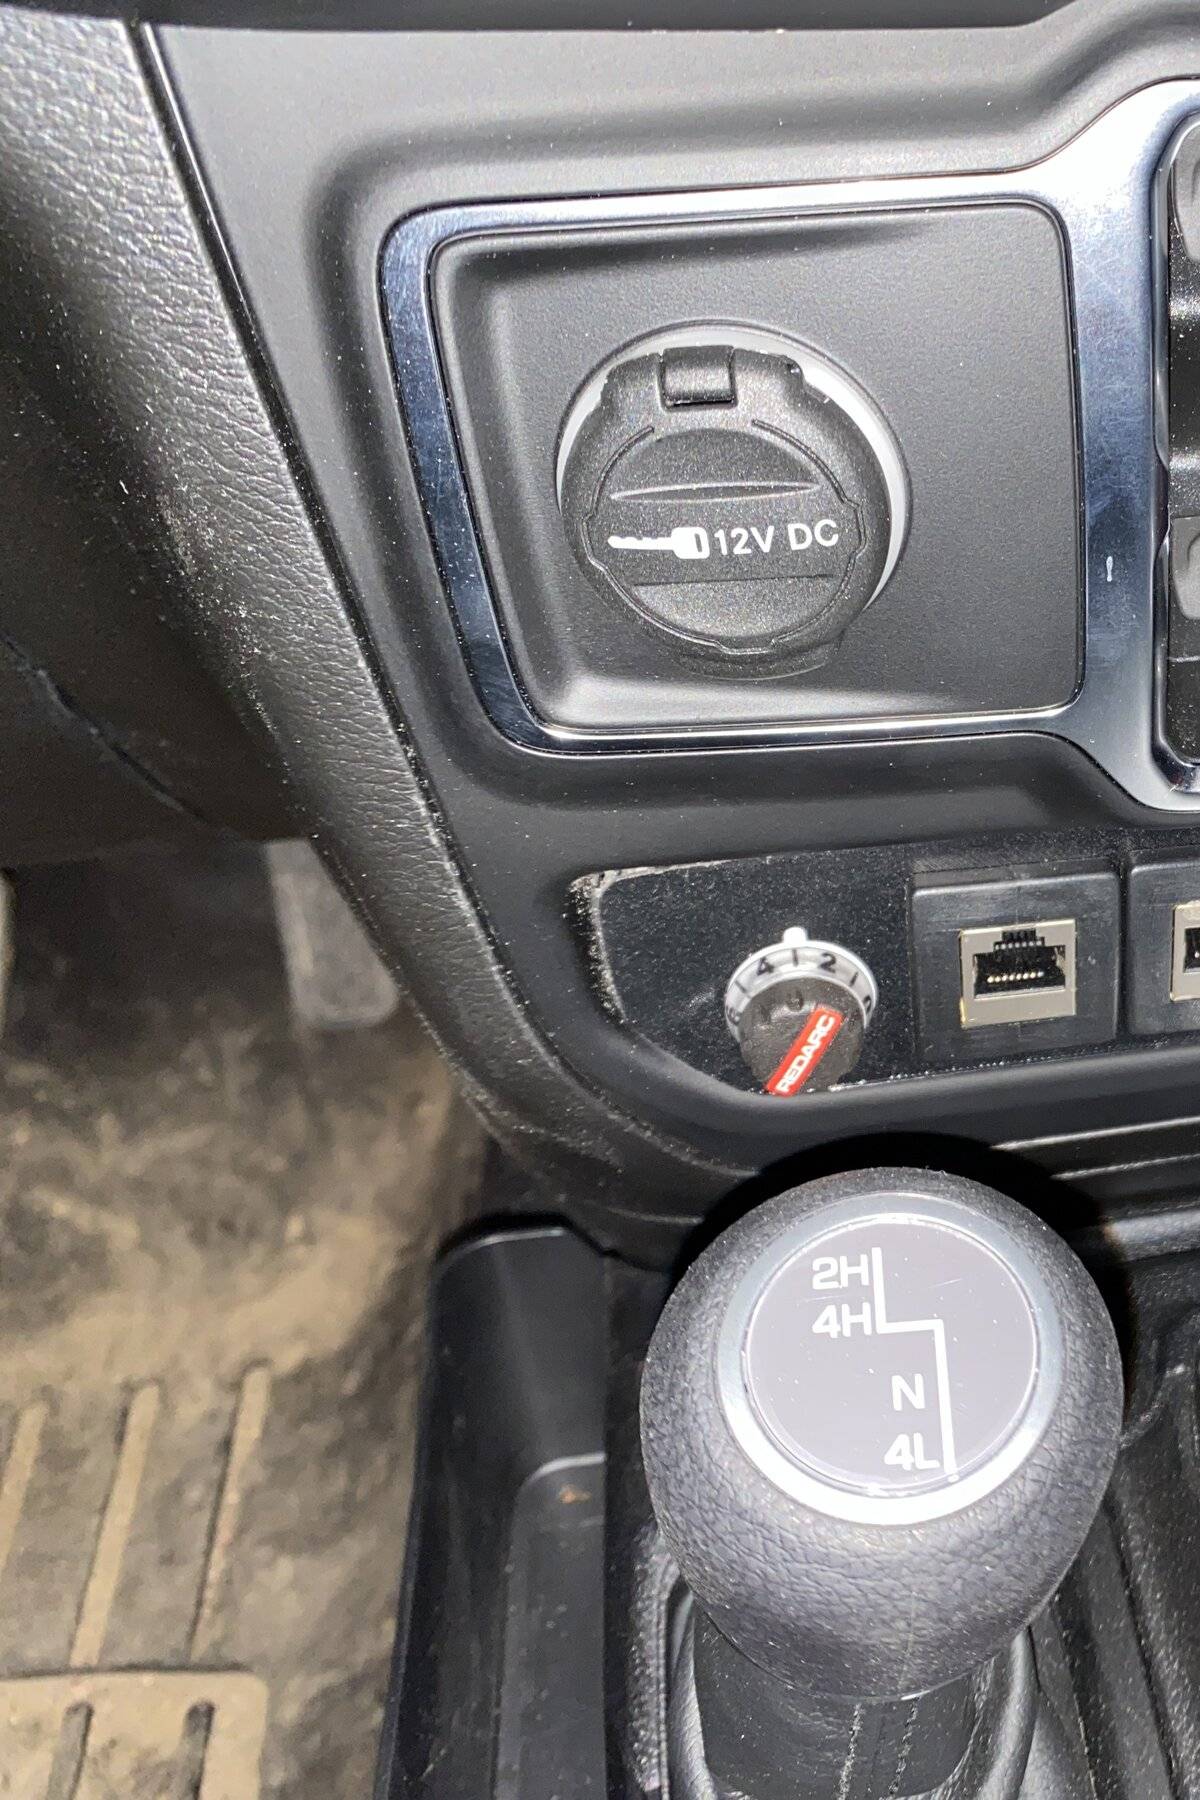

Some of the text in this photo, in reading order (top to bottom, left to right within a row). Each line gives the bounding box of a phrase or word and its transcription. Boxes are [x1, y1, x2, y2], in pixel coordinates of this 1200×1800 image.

[714, 519, 840, 556] 12V DC
[757, 956, 774, 976] 4
[819, 952, 836, 974] 2
[776, 1014, 836, 1093] REDARC
[811, 1256, 870, 1290] 2H
[812, 1303, 872, 1338] 4H
[891, 1373, 925, 1411] N
[884, 1432, 940, 1470] 4L
